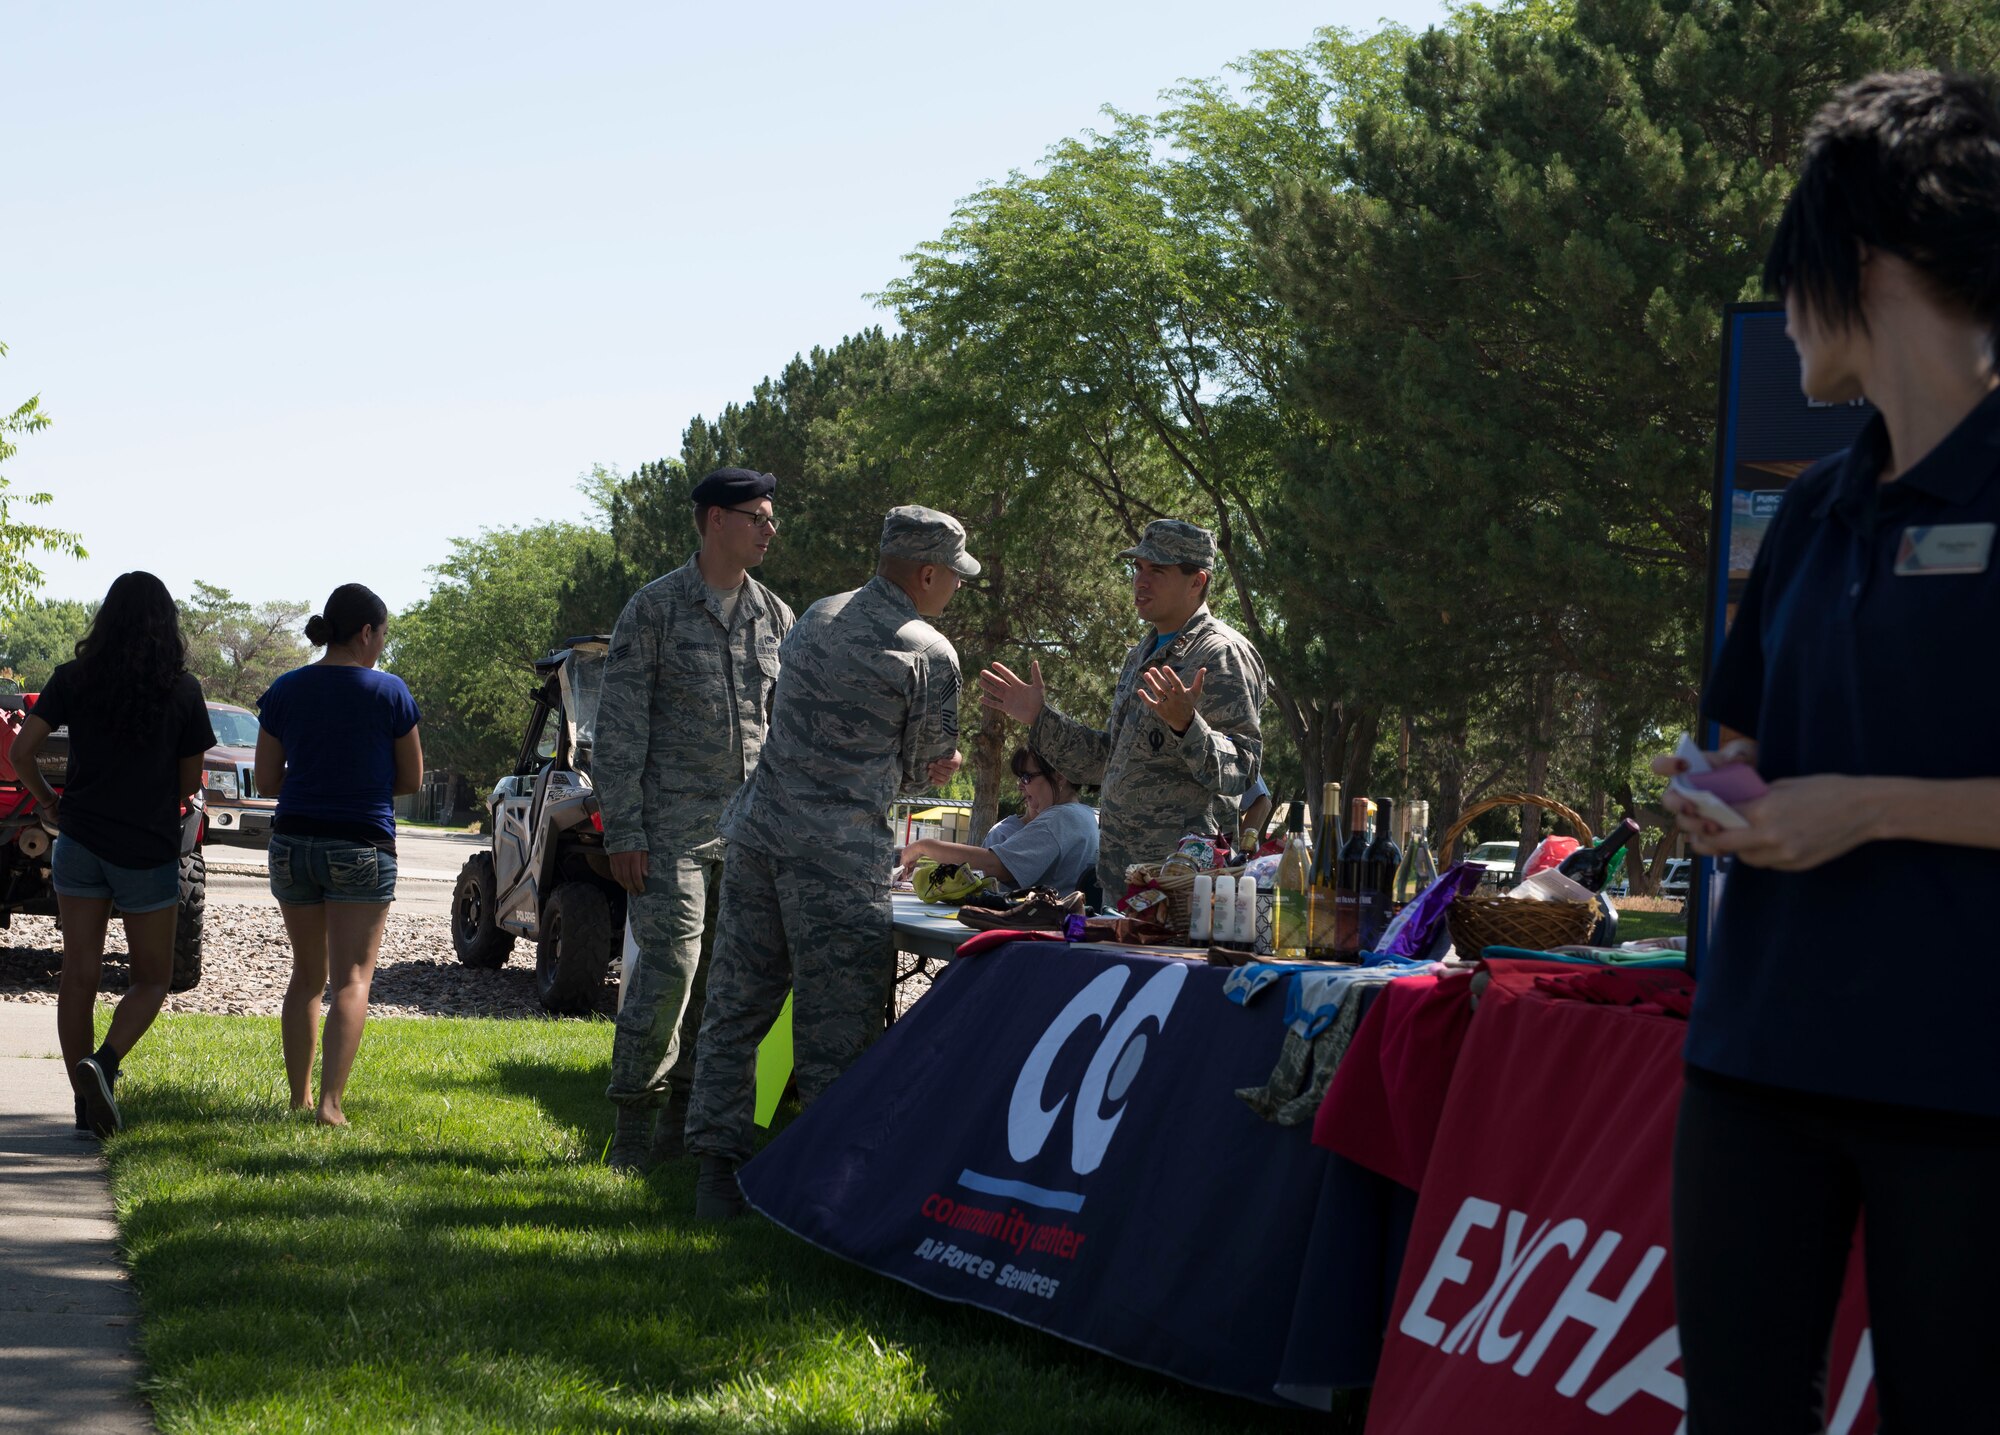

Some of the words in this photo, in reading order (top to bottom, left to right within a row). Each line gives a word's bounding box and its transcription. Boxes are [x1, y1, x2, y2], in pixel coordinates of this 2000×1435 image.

[515, 910, 536, 924] POLARIS
[921, 1193, 1033, 1255] community
[1033, 1223, 1086, 1259] center
[914, 1238, 944, 1260] Air
[938, 1244, 996, 1279] Force
[995, 1263, 1061, 1299] Services
[1400, 1196, 1688, 1435] EXCHA
